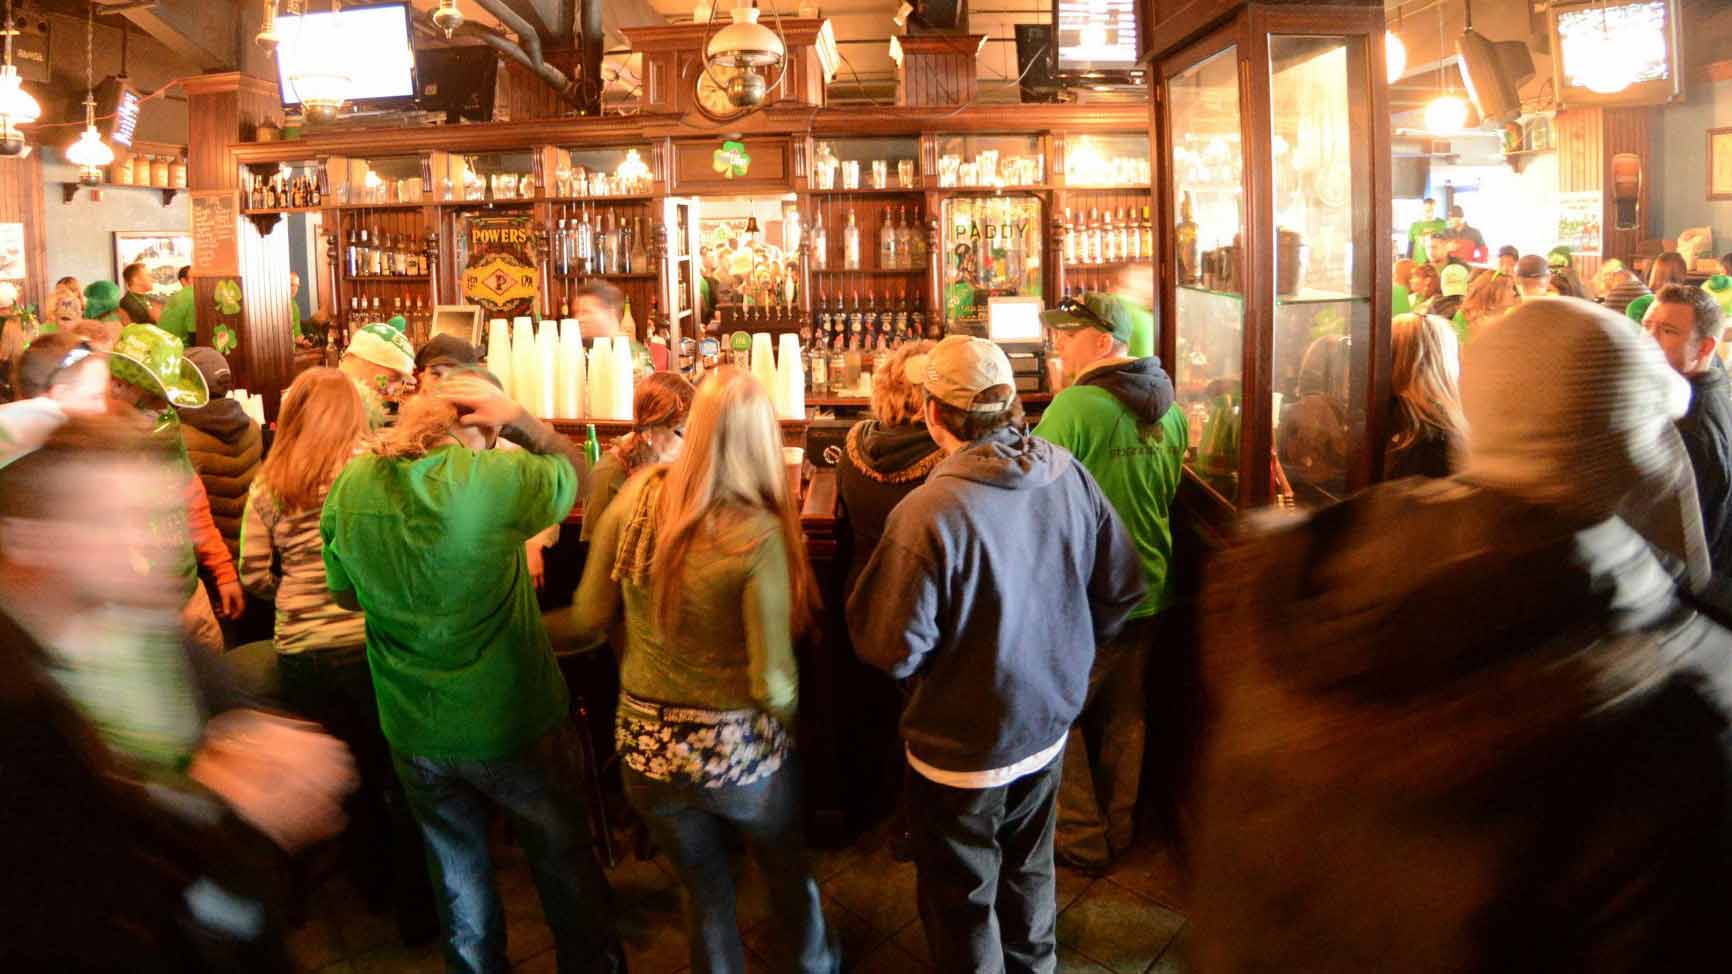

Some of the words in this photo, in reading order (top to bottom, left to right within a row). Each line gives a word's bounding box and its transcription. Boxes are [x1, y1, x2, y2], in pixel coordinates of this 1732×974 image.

[472, 228, 527, 243] POWERS
[956, 221, 1028, 240] PADDY
[495, 274, 507, 290] P
